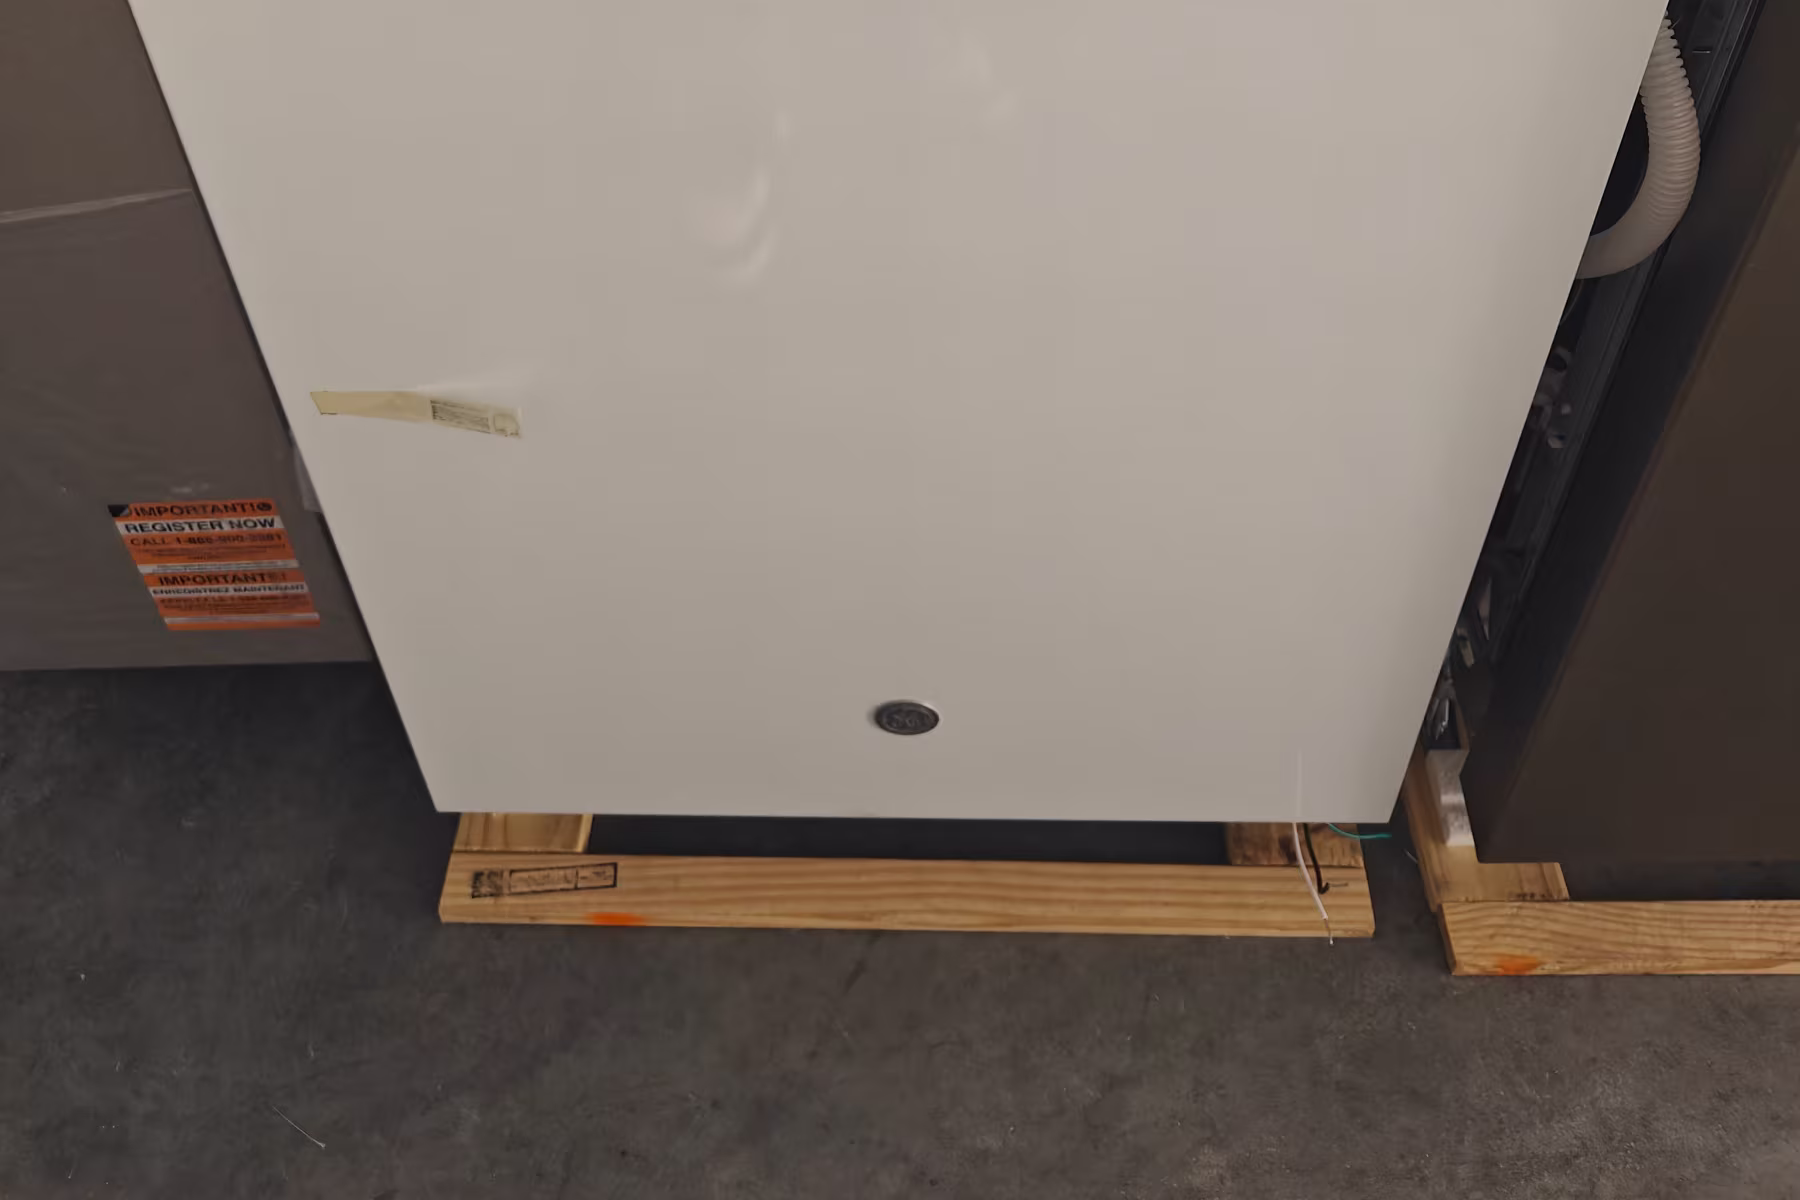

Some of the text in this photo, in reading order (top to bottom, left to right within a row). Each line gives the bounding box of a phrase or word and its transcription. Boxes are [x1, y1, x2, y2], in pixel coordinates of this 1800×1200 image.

[134, 503, 255, 517] IMPORTANT!
[125, 517, 275, 534] REGISTER NOW
[130, 537, 166, 546] CALL
